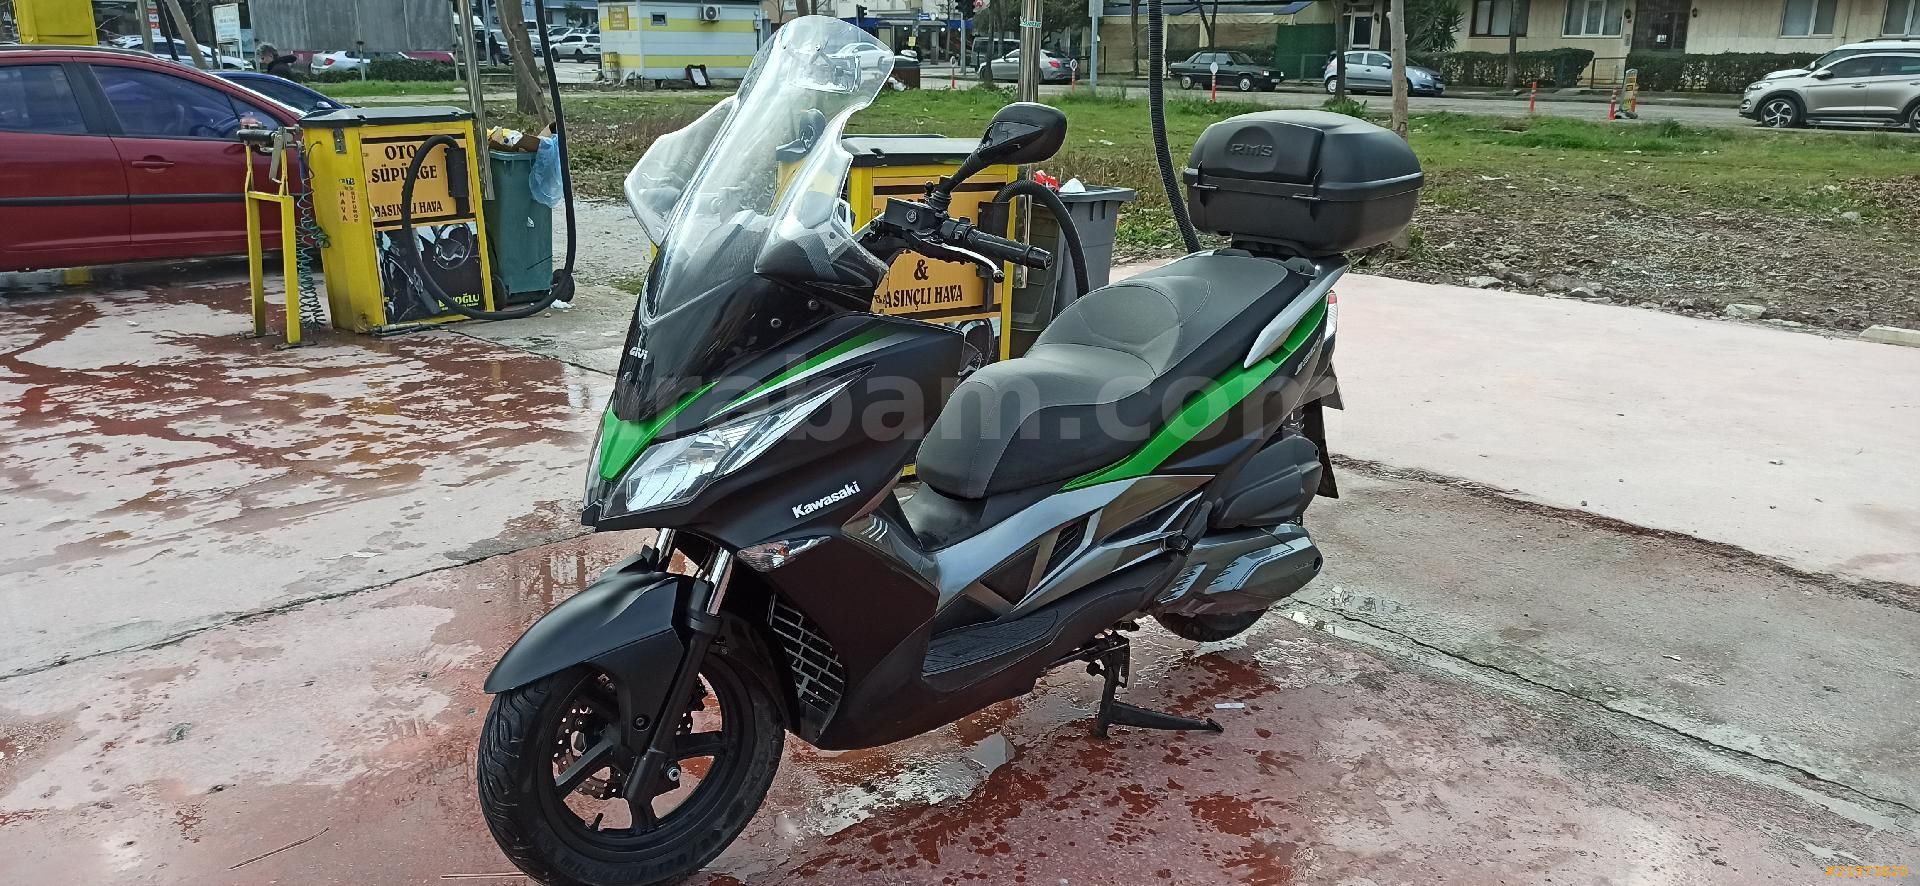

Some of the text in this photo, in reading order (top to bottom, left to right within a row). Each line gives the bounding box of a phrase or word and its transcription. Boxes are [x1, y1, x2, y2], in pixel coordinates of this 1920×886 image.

[384, 144, 418, 160] OTO
[1230, 143, 1273, 157] RMS
[371, 163, 437, 183] SÜPÜGE
[375, 200, 444, 218] BASINLI HAVA
[913, 259, 929, 281] &
[934, 284, 963, 304] HAVA
[791, 481, 861, 519] Kawasaki
